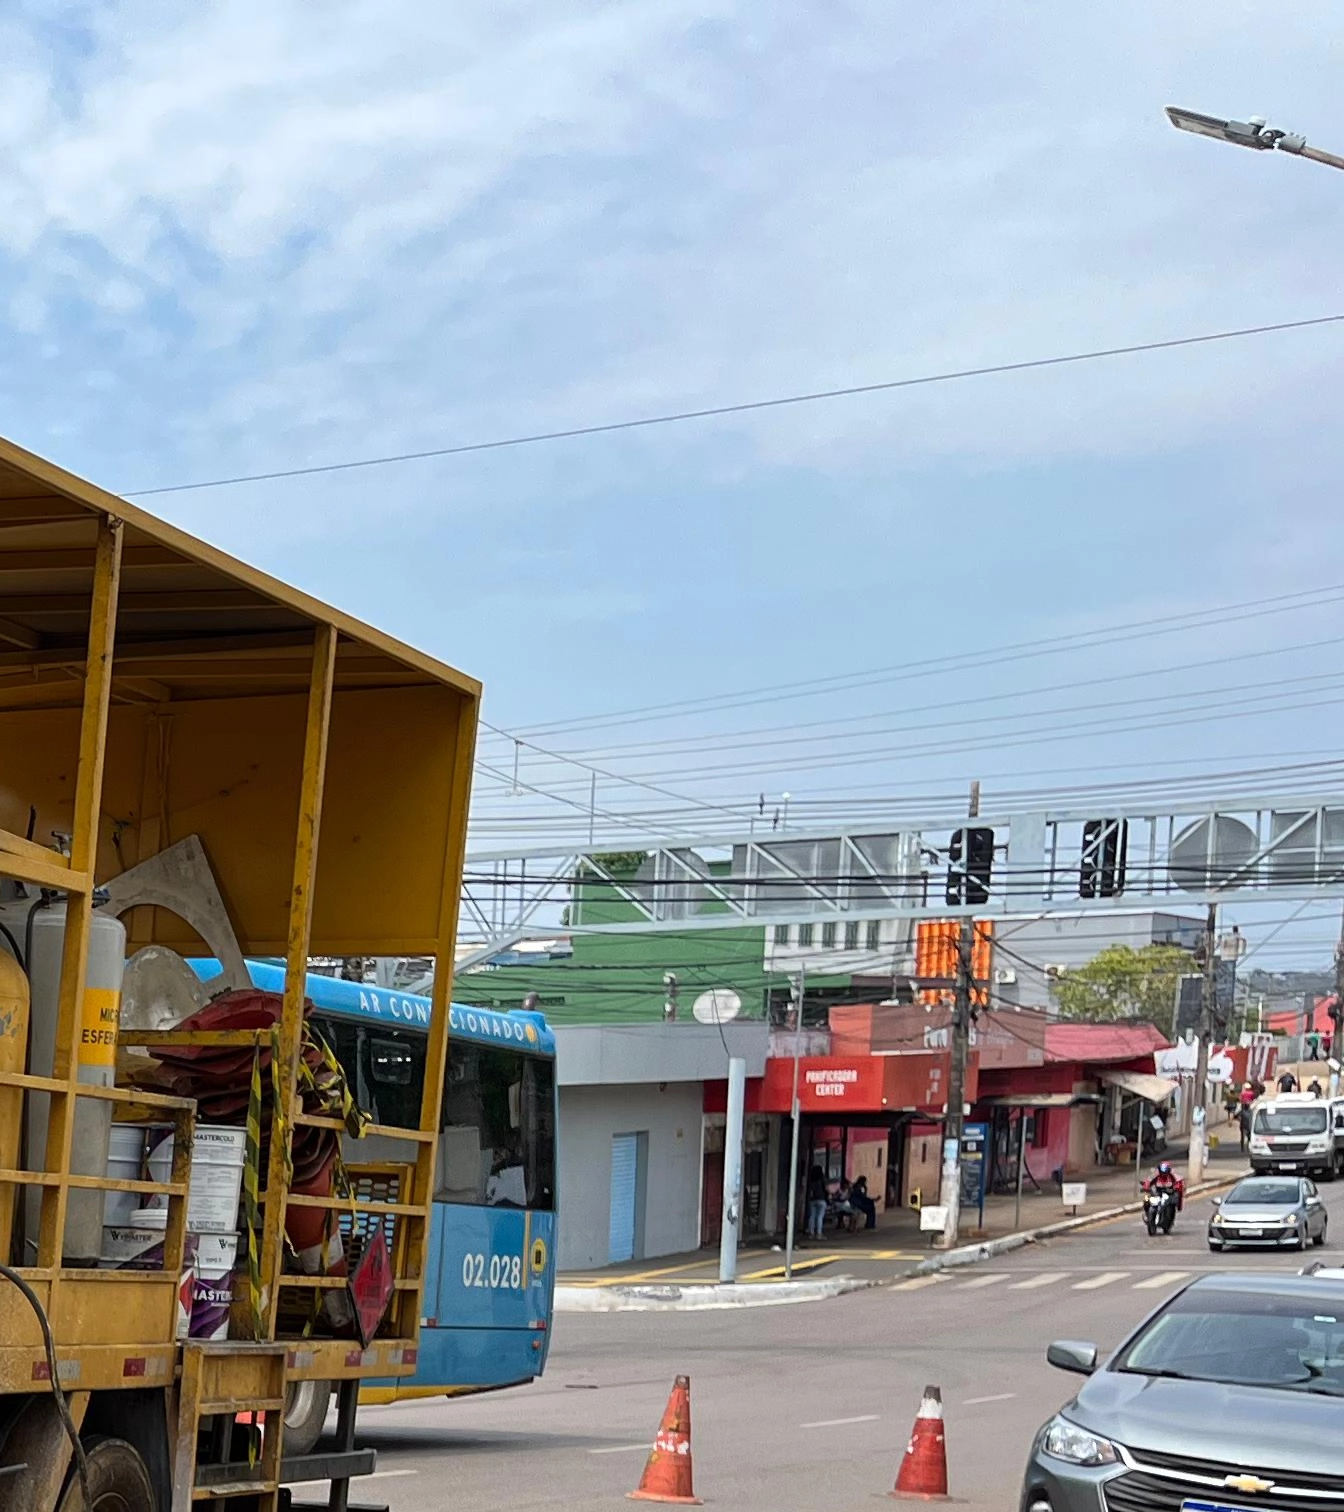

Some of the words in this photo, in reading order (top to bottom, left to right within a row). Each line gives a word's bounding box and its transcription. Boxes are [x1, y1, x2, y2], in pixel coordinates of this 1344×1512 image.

[359, 991, 381, 1014] AR
[389, 997, 524, 1042] CONCIONADO
[815, 1083, 845, 1097] CENTER
[462, 1252, 521, 1289] 02.028
